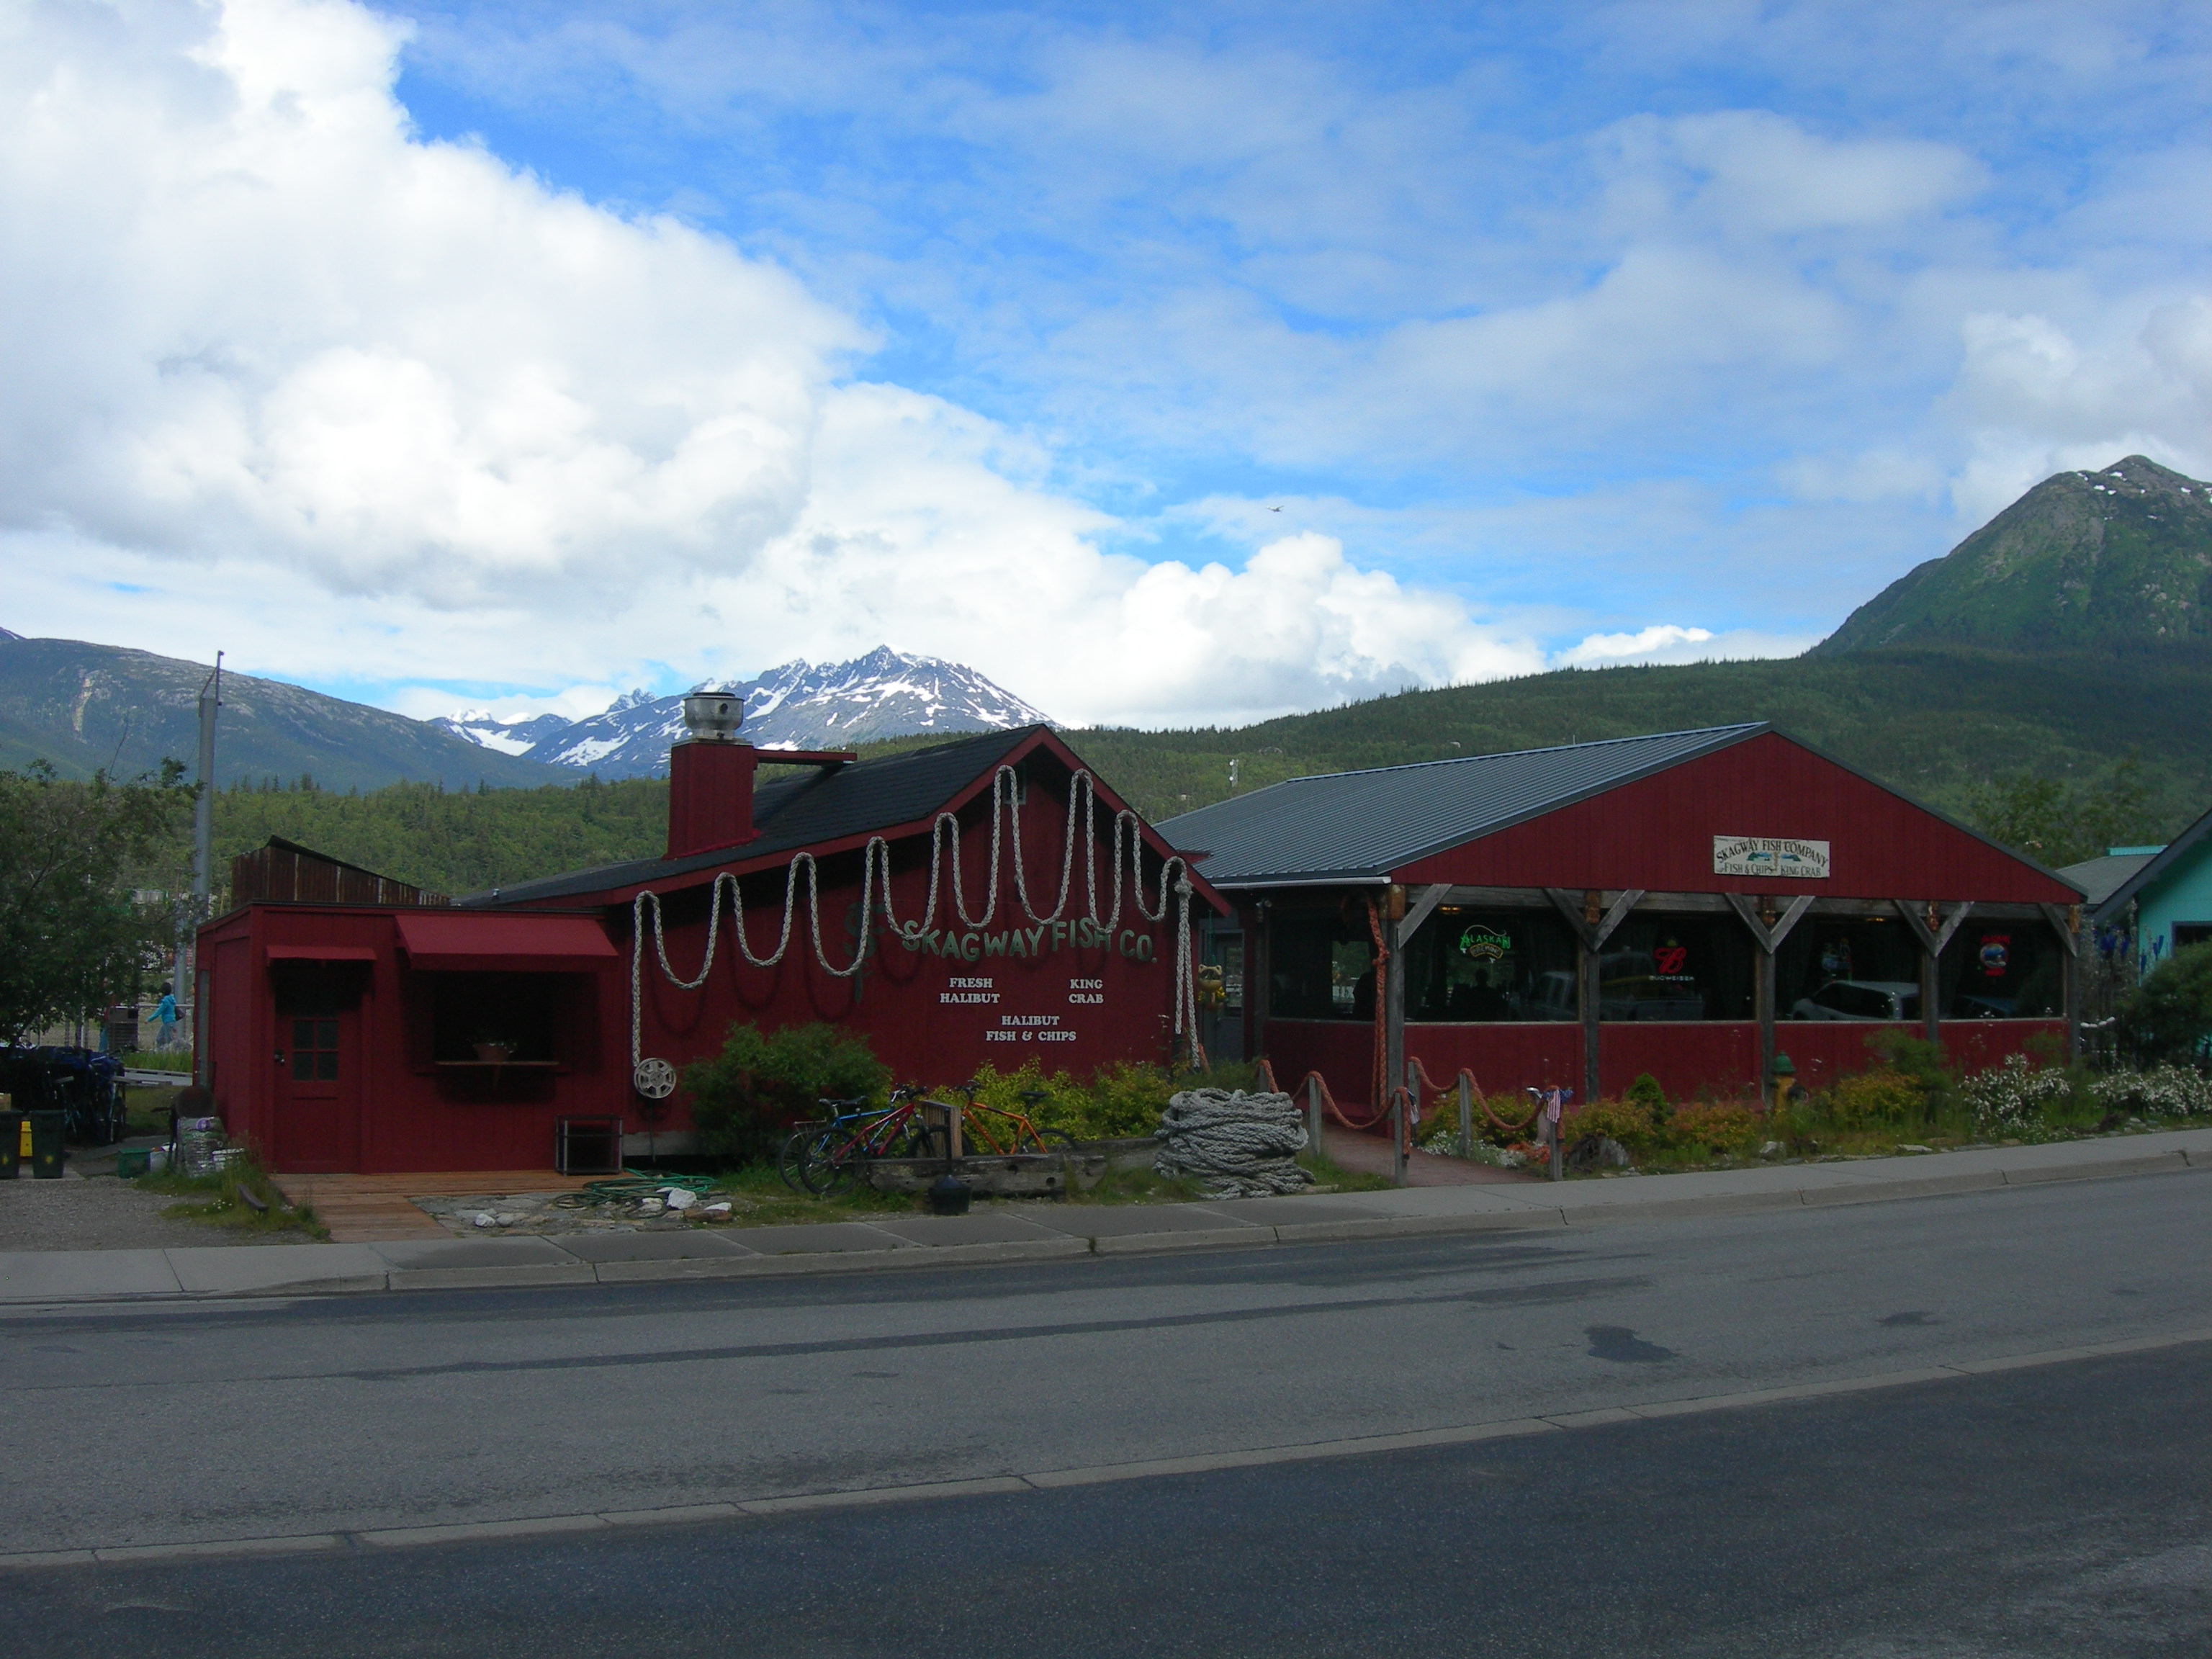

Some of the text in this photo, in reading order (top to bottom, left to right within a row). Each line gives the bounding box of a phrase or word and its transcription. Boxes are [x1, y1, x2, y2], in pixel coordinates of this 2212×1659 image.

[1717, 840, 1828, 868] SKAGWAY FISH COMPANY
[1725, 862, 1743, 873] FISH
[1745, 864, 1750, 875] &
[1781, 865, 1799, 876] KING
[1801, 866, 1821, 877] CRAB
[902, 917, 1158, 964] SKAGWAY FISH CO.
[1460, 933, 1511, 949] ALASKAN
[949, 977, 993, 989] FRESH
[1070, 979, 1103, 989] KING
[940, 992, 1001, 1004] HALIBUT
[1068, 993, 1104, 1004] CRAB
[1002, 1015, 1060, 1026] HALIBUT
[986, 1030, 1076, 1041] FISH & CHIPS
